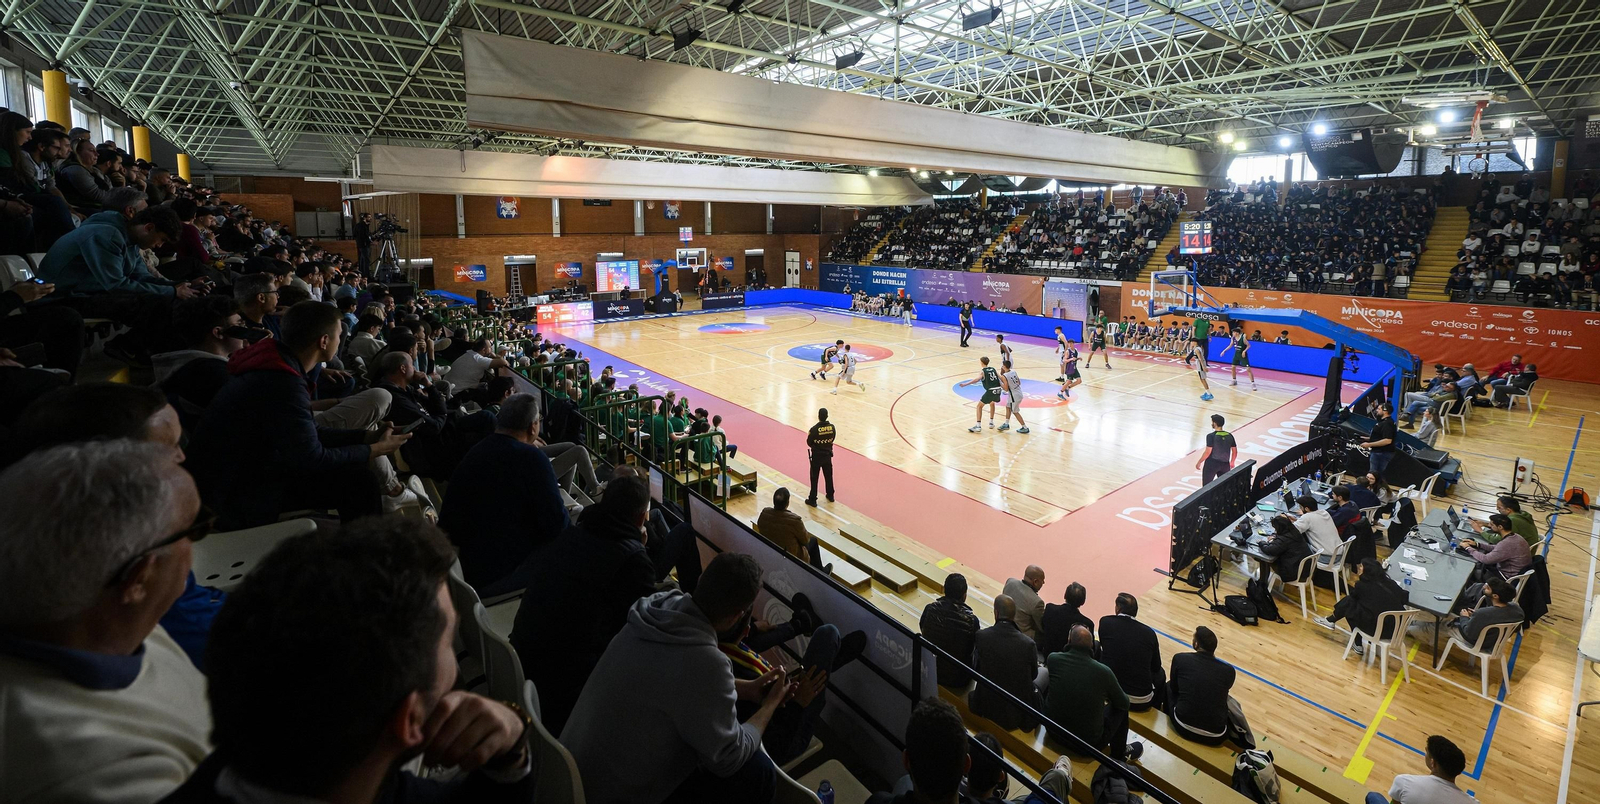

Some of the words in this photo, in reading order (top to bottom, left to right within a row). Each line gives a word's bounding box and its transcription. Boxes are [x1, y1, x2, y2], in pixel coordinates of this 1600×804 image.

[1183, 235, 1200, 247] 14
[1186, 312, 1219, 320] endesa
[1431, 320, 1477, 330] endesa
[988, 372, 997, 381] 34
[1260, 469, 1283, 489] actuamos
[1283, 461, 1298, 474] contra
[1298, 456, 1303, 465] el
[1303, 448, 1322, 463] bullying
